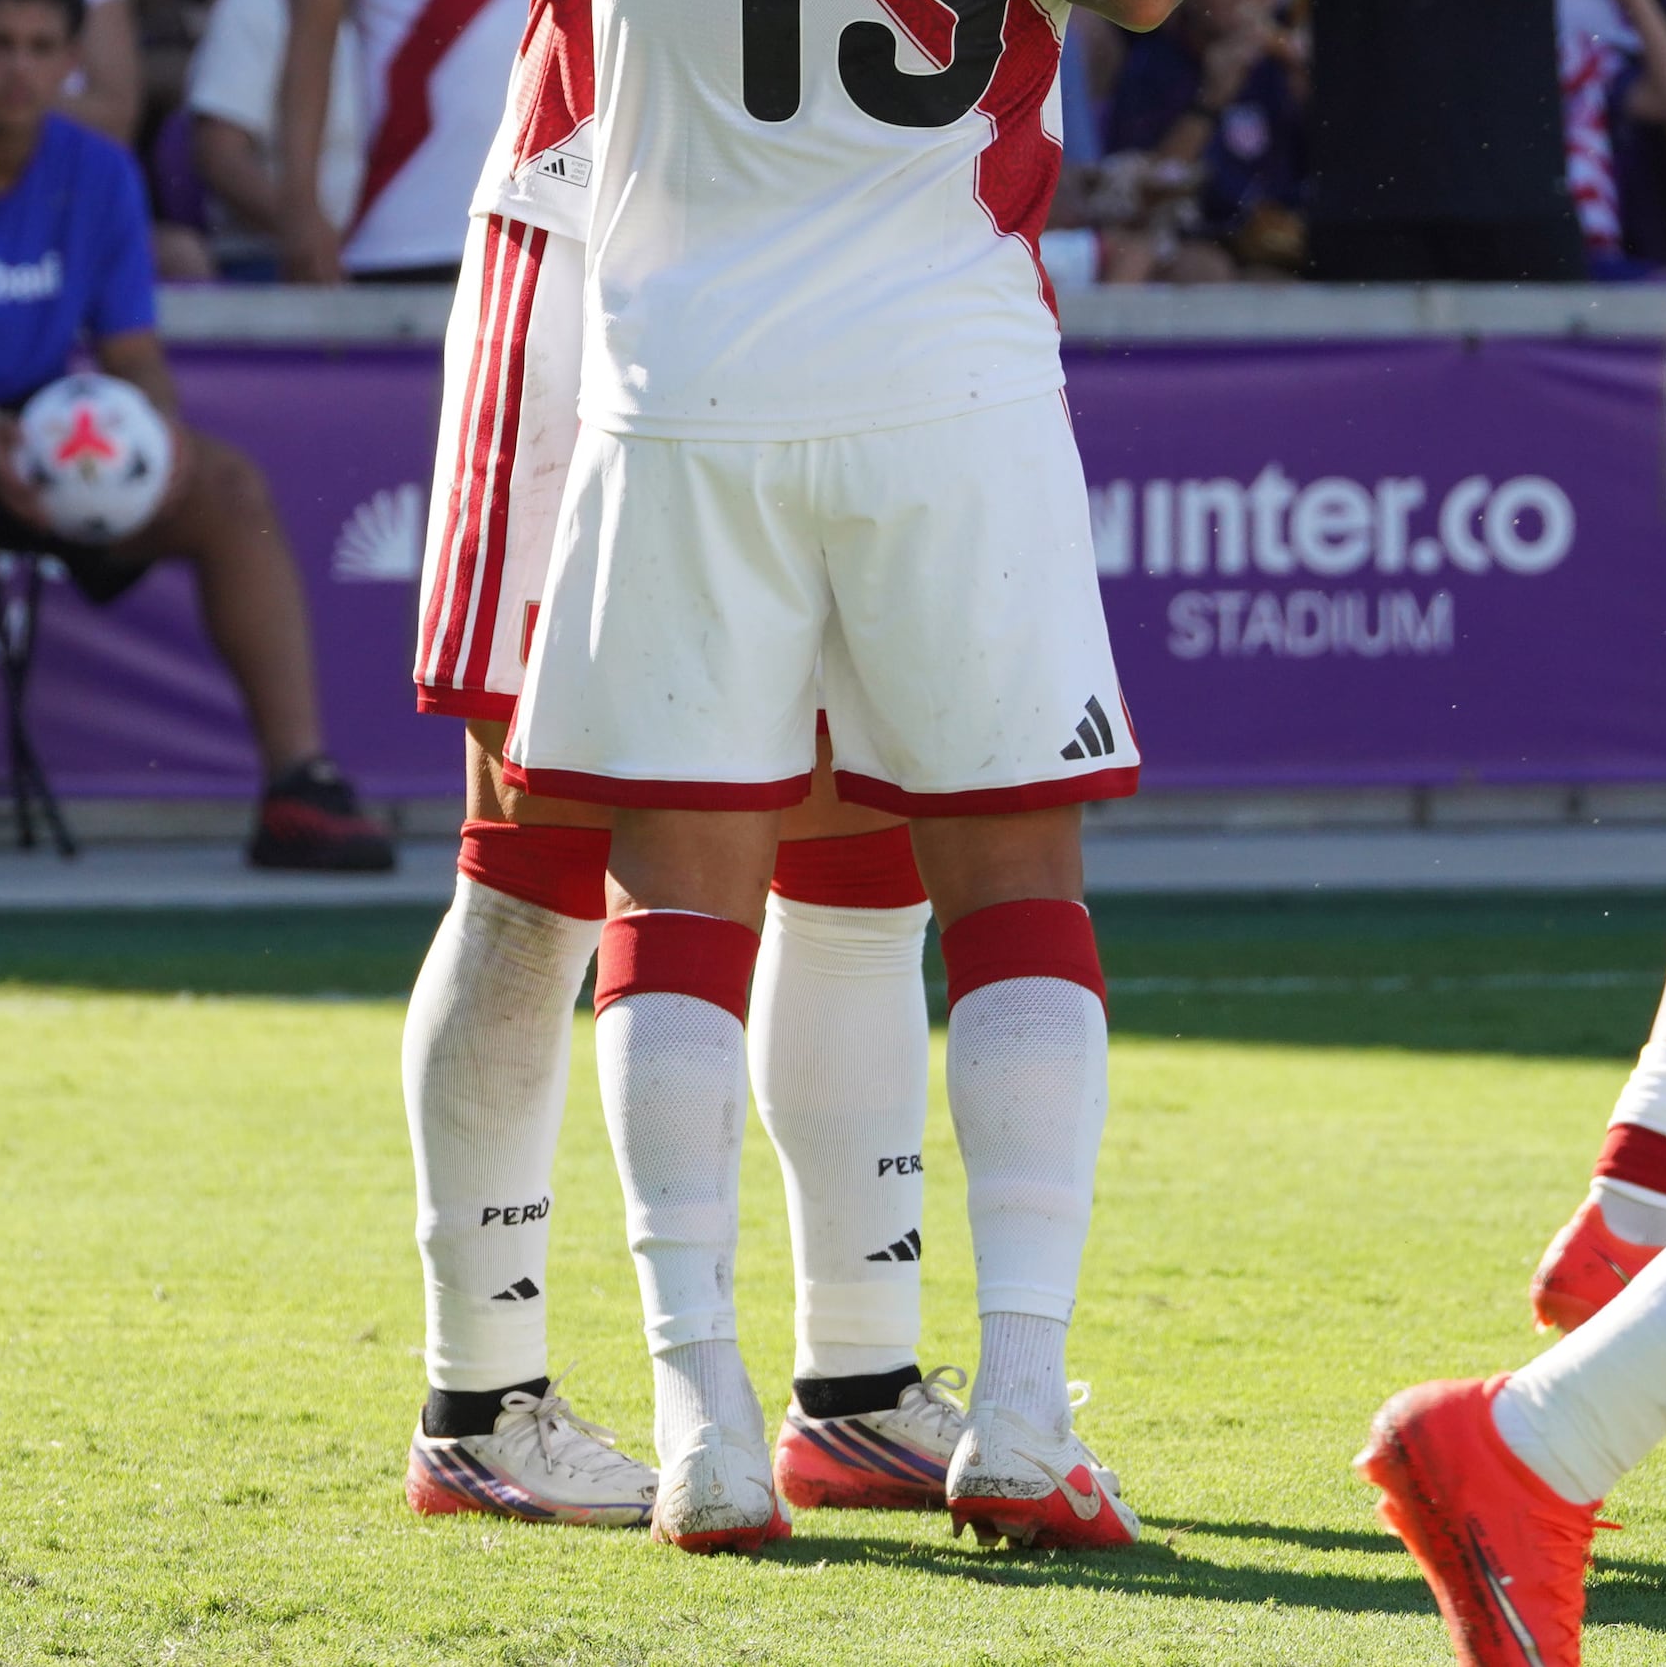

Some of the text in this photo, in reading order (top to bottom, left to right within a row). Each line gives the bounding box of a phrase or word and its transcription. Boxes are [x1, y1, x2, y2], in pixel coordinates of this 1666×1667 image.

[1144, 462, 1576, 577] inter.co
[1167, 590, 1456, 660] STADIUM
[877, 1150, 925, 1178] PER
[480, 1195, 550, 1228] PERÚ
